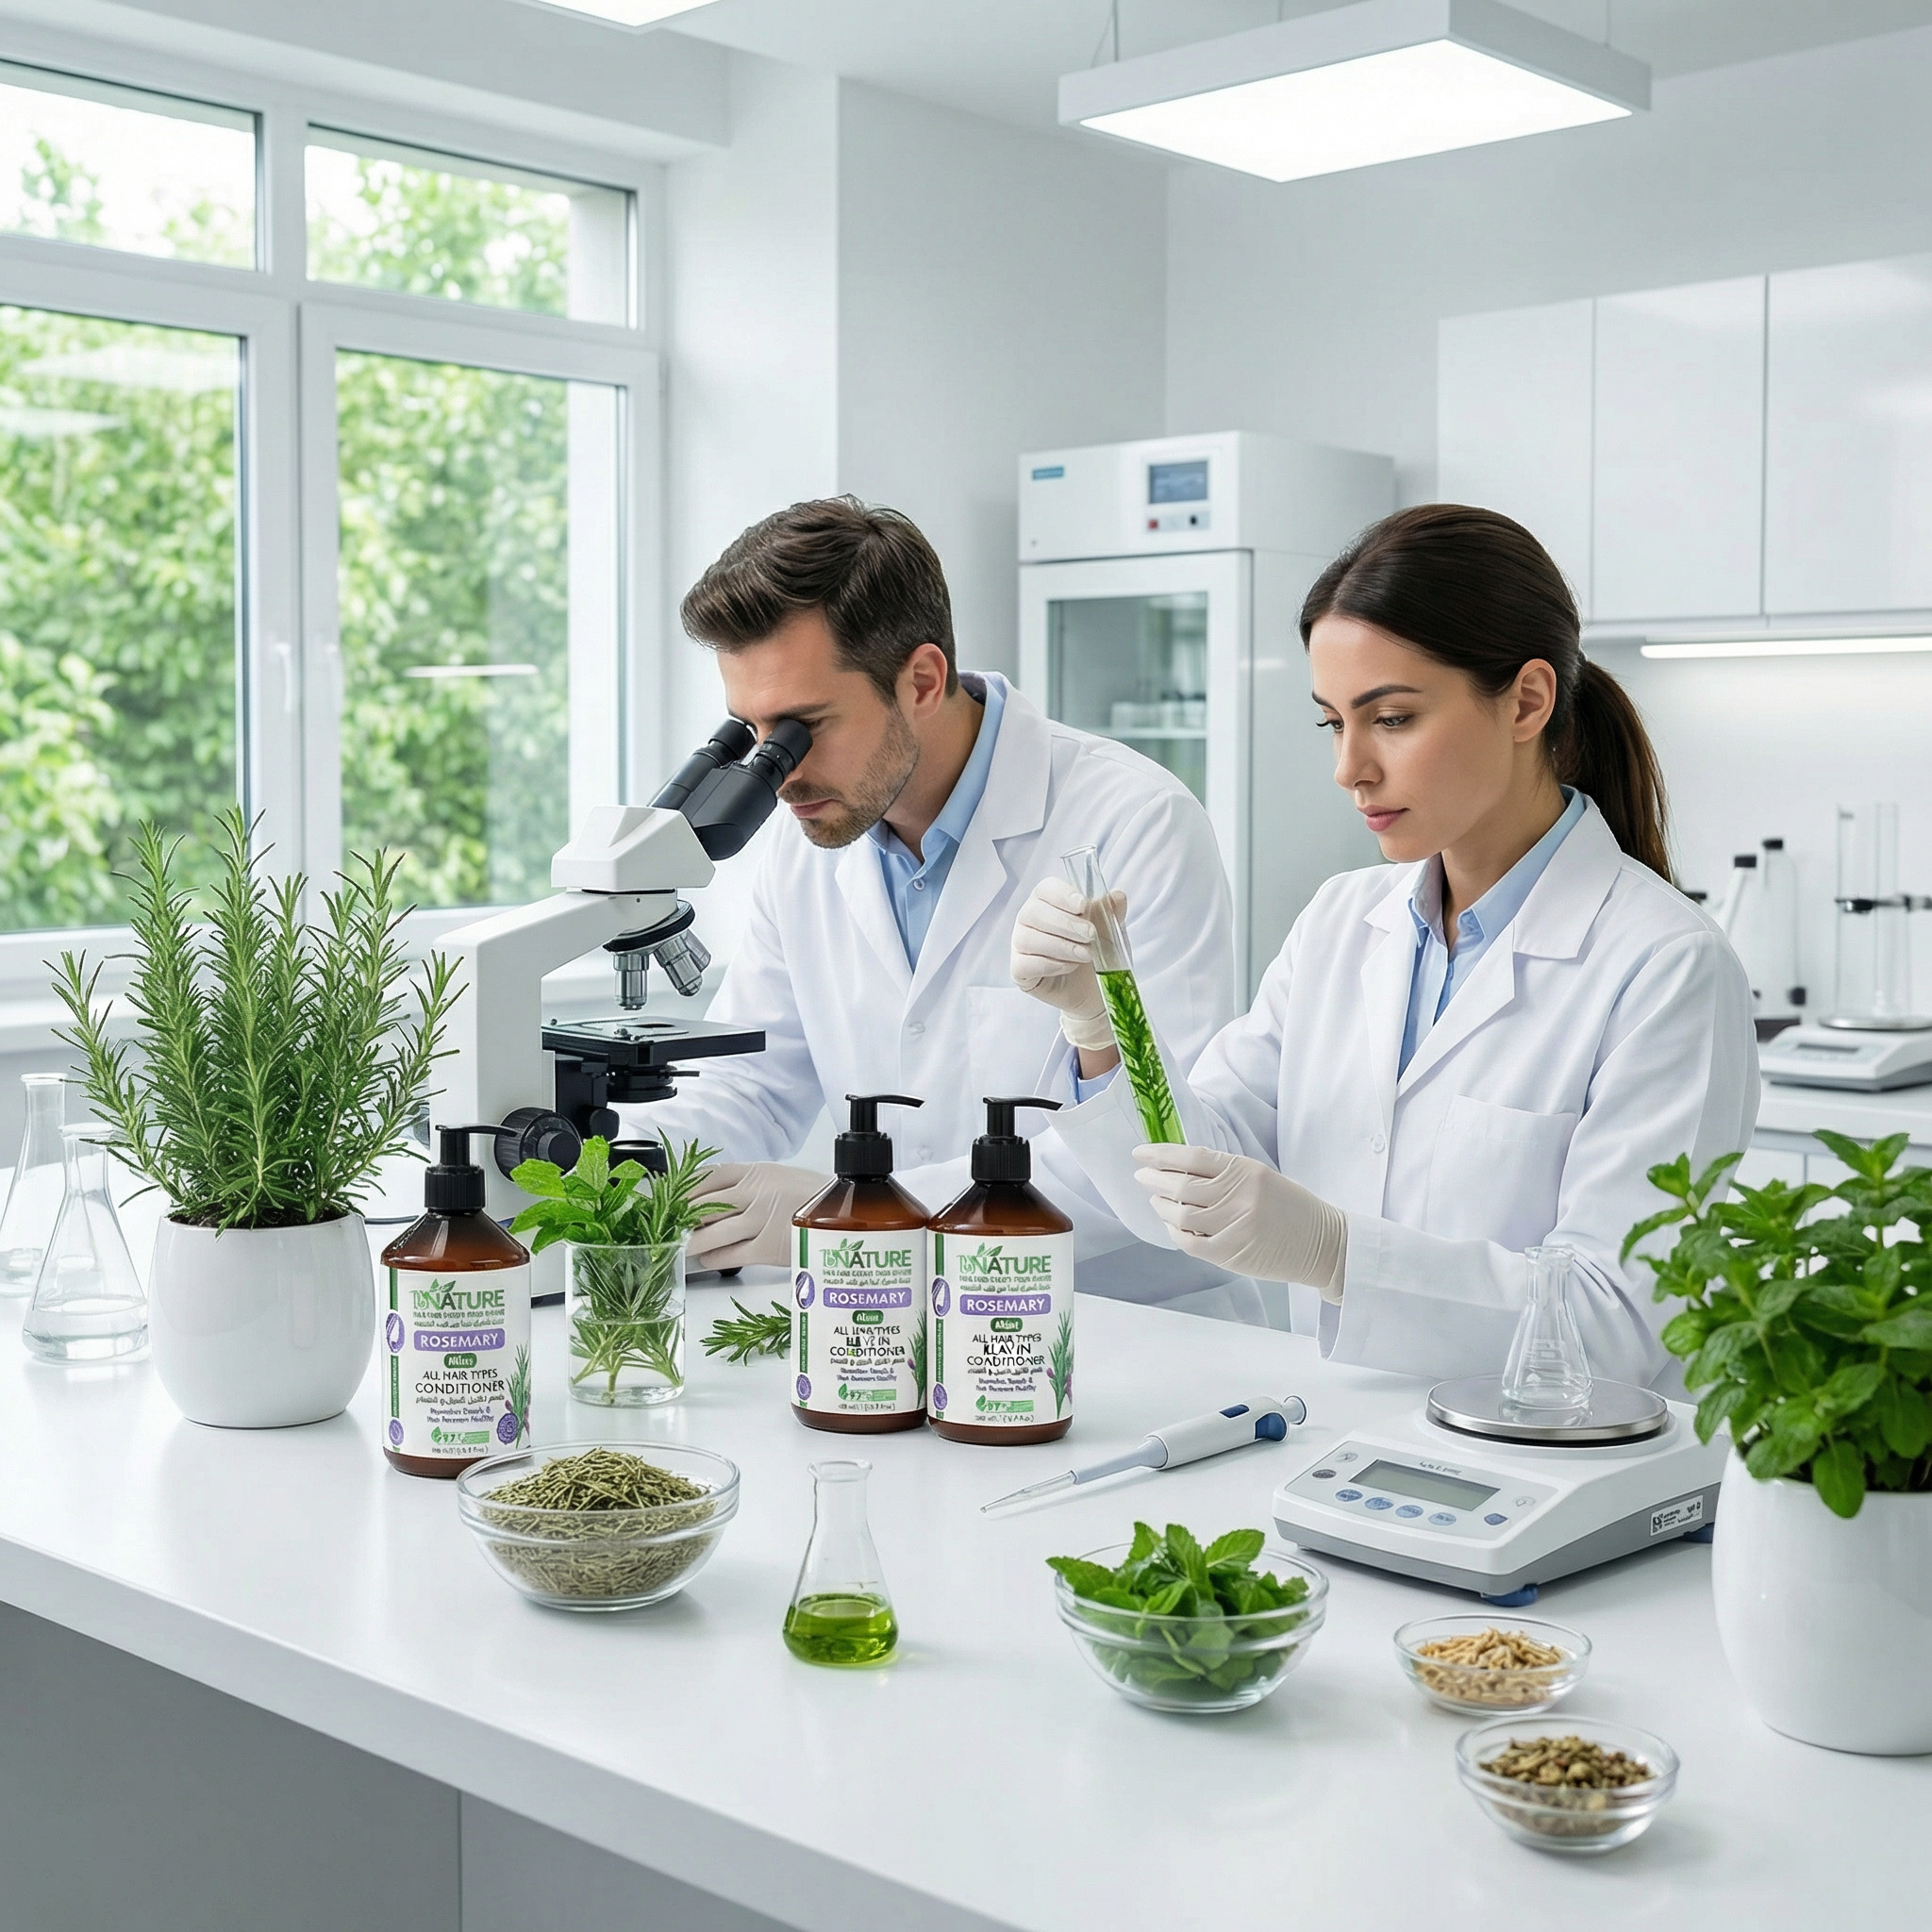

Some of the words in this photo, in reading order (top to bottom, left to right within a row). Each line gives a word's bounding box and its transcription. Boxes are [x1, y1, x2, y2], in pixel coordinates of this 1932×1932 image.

[829, 1291, 906, 1305] ROSEMARY
[967, 1298, 1045, 1312] ROSEMARY
[421, 1332, 499, 1348] ROSEMARY
[972, 1334, 988, 1343] ALL
[442, 1370, 468, 1380] HAIR
[472, 1368, 498, 1379] TYPES
[415, 1380, 506, 1394] CONDITIONER
